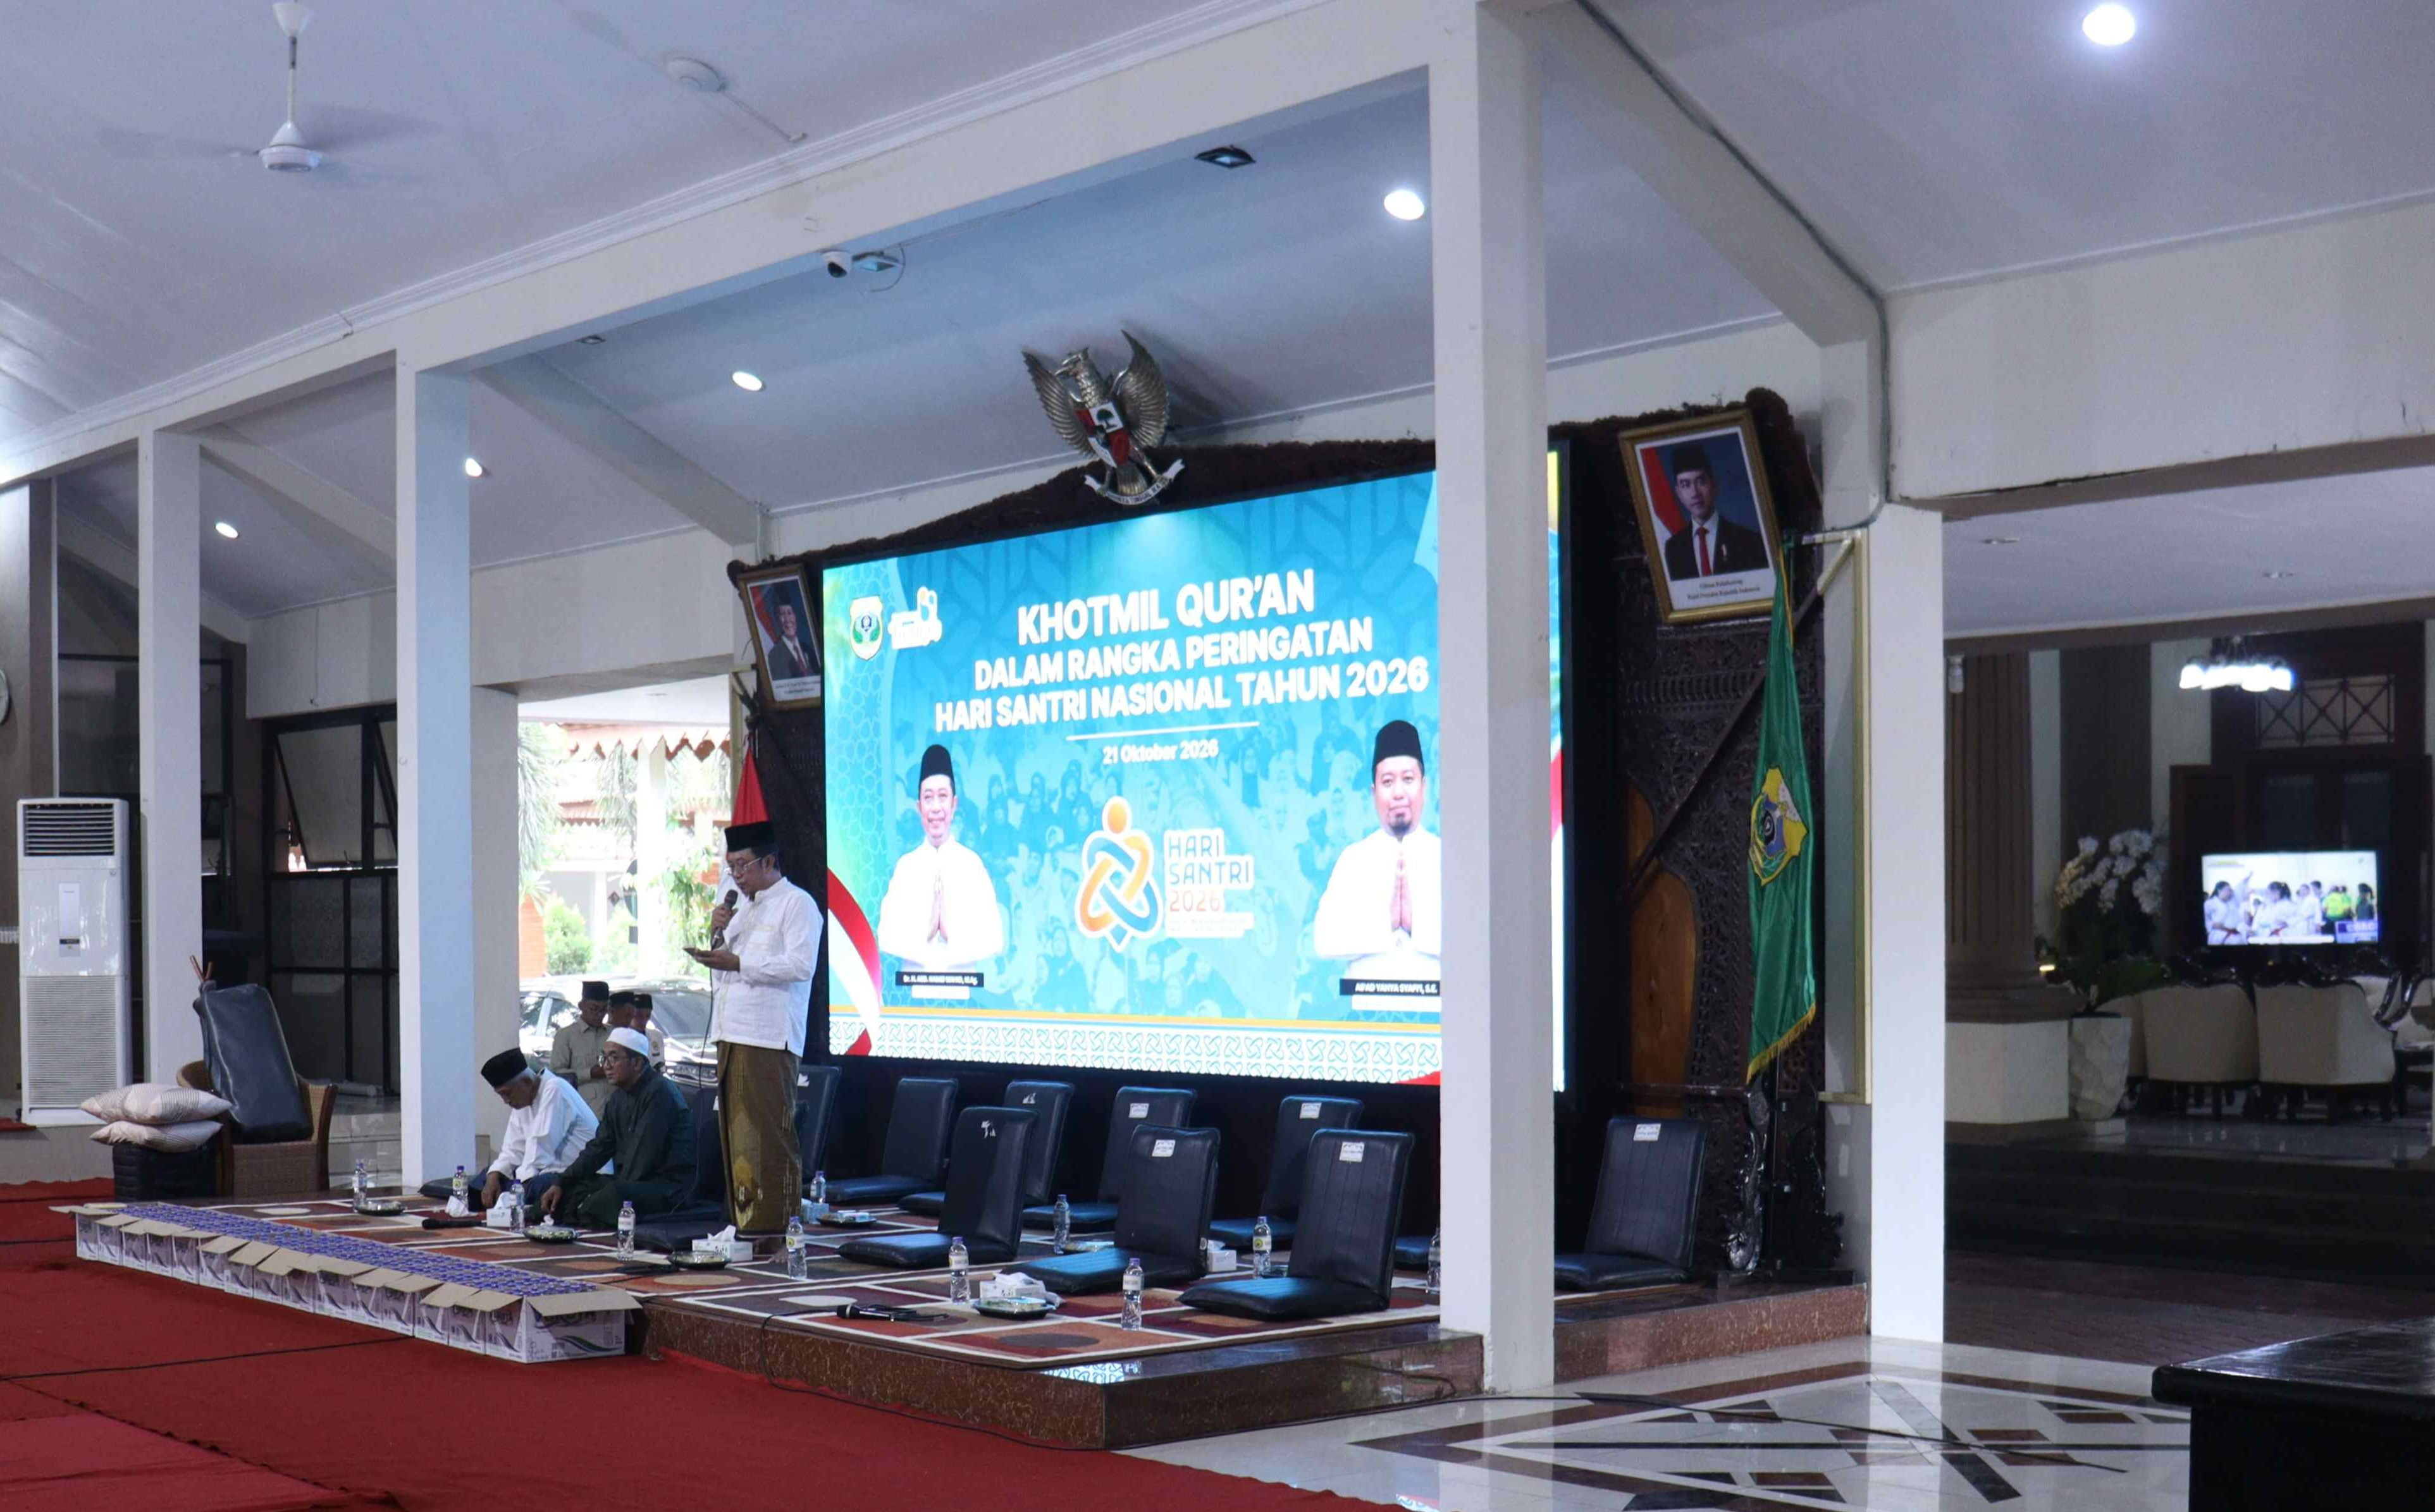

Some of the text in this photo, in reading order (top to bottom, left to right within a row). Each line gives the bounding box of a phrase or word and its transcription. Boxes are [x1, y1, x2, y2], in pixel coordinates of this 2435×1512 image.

[1019, 569, 1314, 645] KHOTMIL QUR'AN
[975, 617, 1372, 690] DALAM RANGKA PERINGATAN
[936, 656, 1429, 732] HARI SANTRI NASIONAL TAHUN 2026
[1103, 739, 1219, 764] 21 Oktober 2026
[1169, 834, 1219, 857] HARI
[1169, 861, 1250, 885] SANTRI
[1169, 888, 1220, 912] 2026
